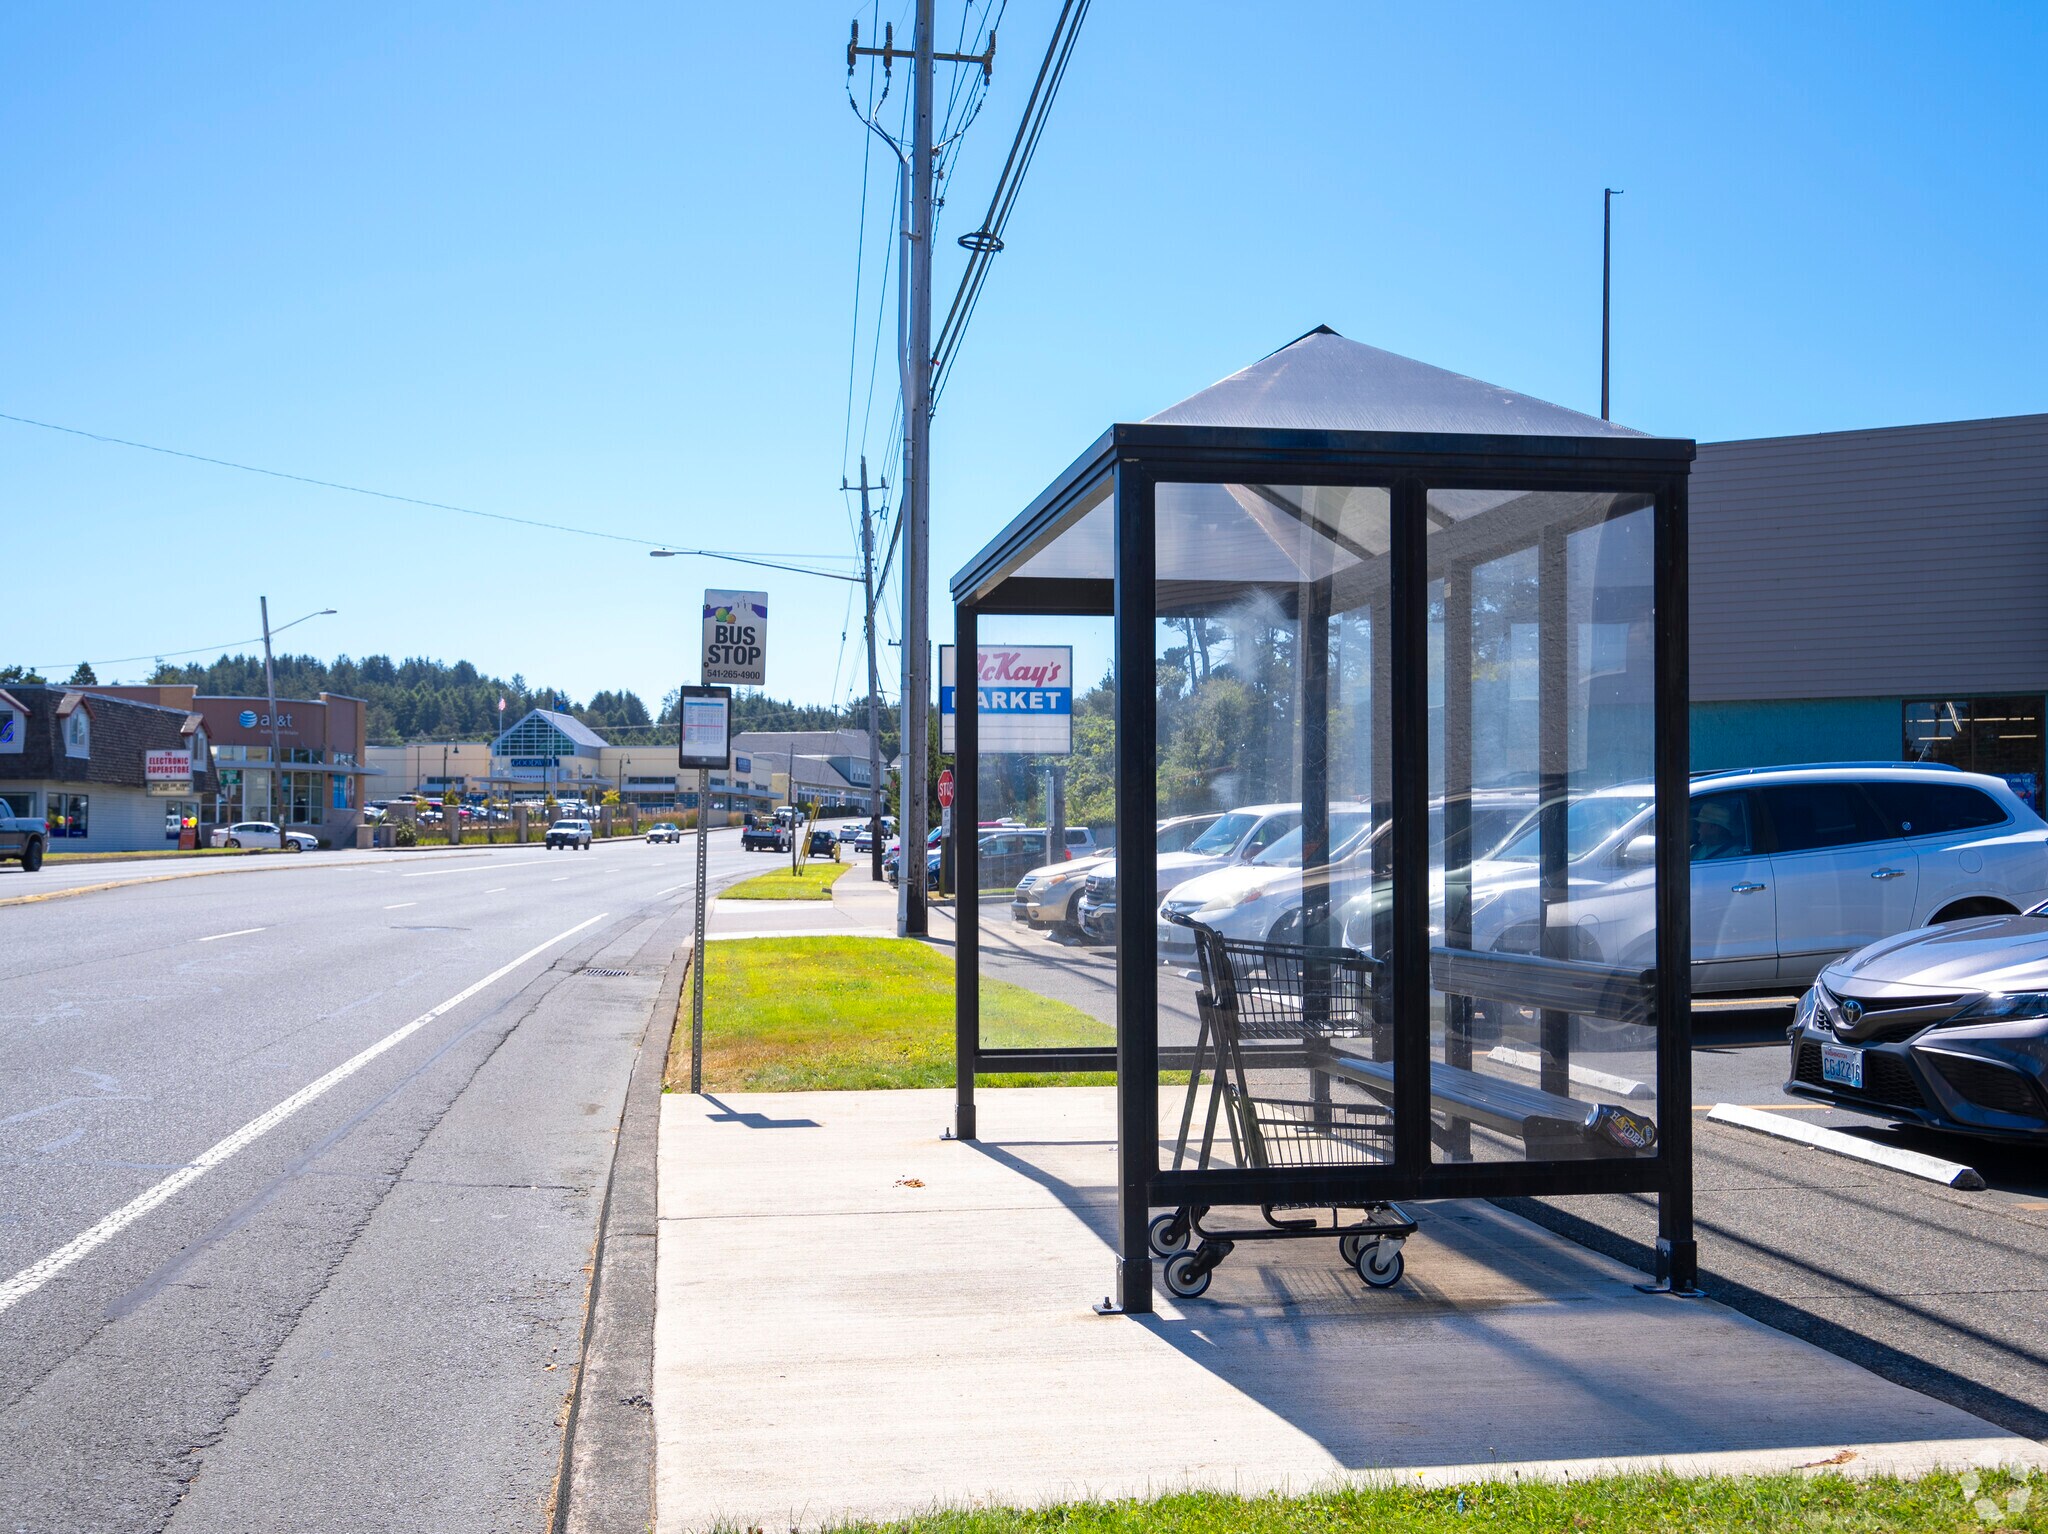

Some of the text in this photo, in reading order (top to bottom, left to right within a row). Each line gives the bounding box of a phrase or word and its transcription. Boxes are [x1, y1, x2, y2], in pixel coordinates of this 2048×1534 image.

[715, 625, 756, 646] BUS
[708, 645, 761, 665] STOP
[952, 691, 1061, 709] ARKET
[260, 713, 292, 727] a&t
[148, 766, 190, 774] SUPERSTORE
[149, 757, 188, 765] ELECTRONIC
[939, 782, 954, 797] STOP
[1824, 1057, 1860, 1082] CGJ2216
[1610, 1110, 1646, 1148] HARDER
